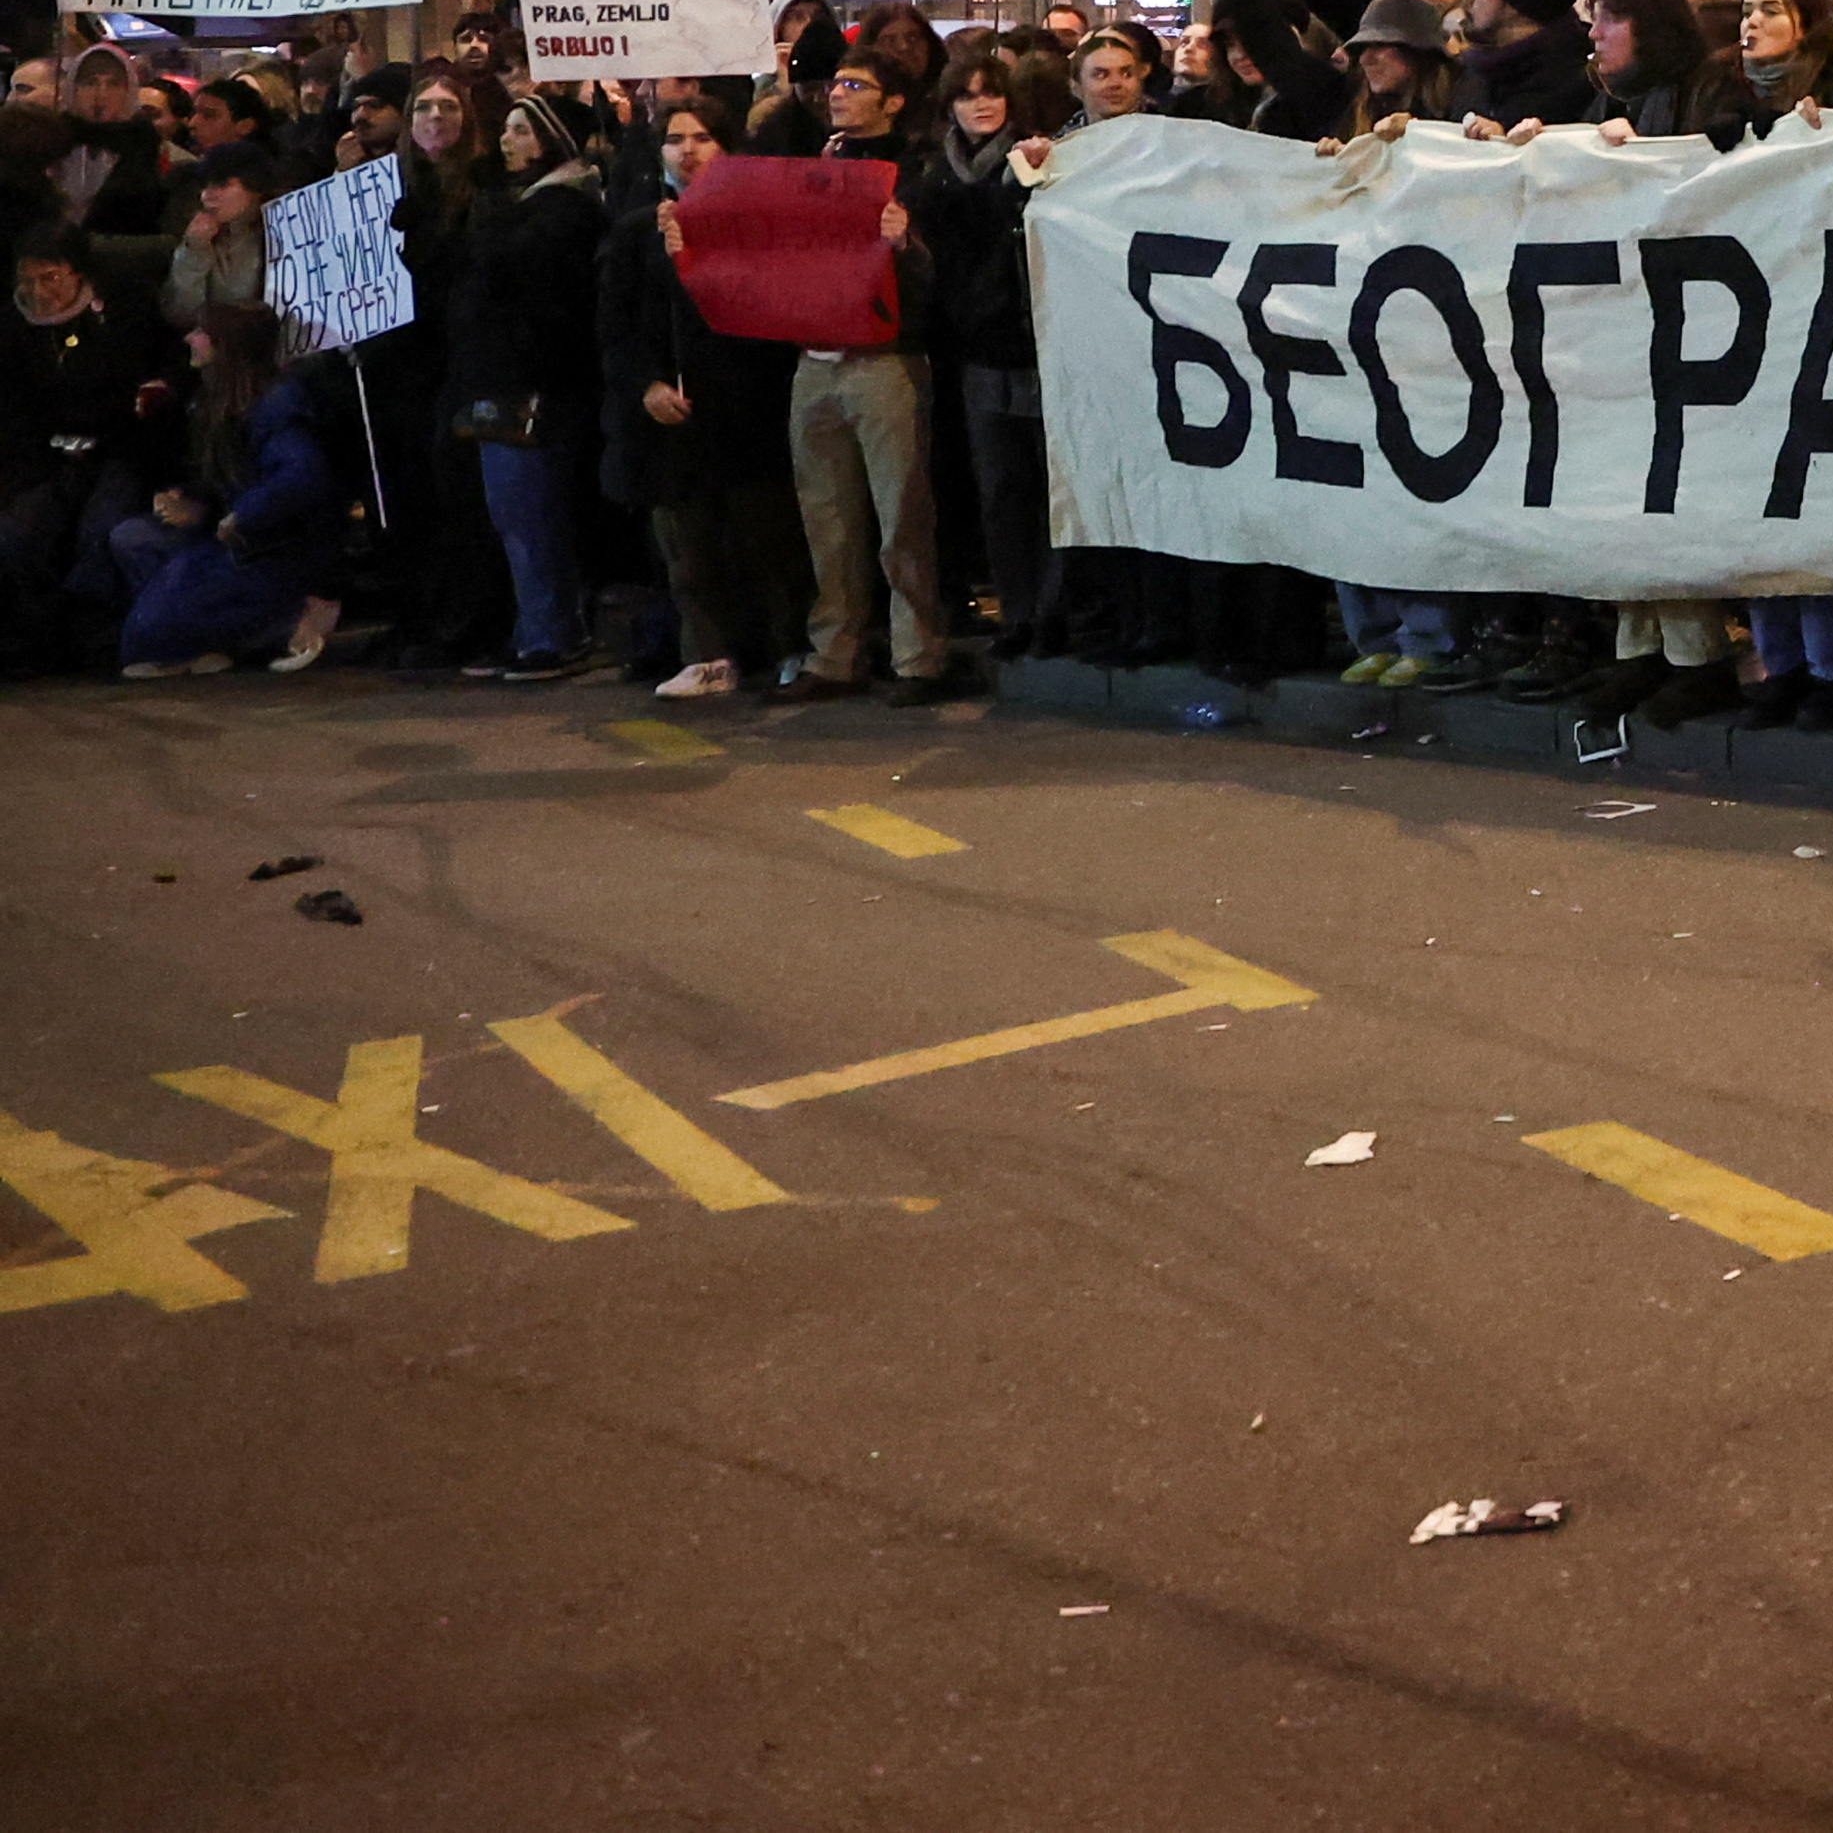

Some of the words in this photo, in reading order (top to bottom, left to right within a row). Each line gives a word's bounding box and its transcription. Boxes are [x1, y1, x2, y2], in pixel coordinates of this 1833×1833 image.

[532, 4, 590, 25] PRAG,
[596, 3, 670, 22] ZEMLJO
[265, 178, 336, 263] КРЕДИТ
